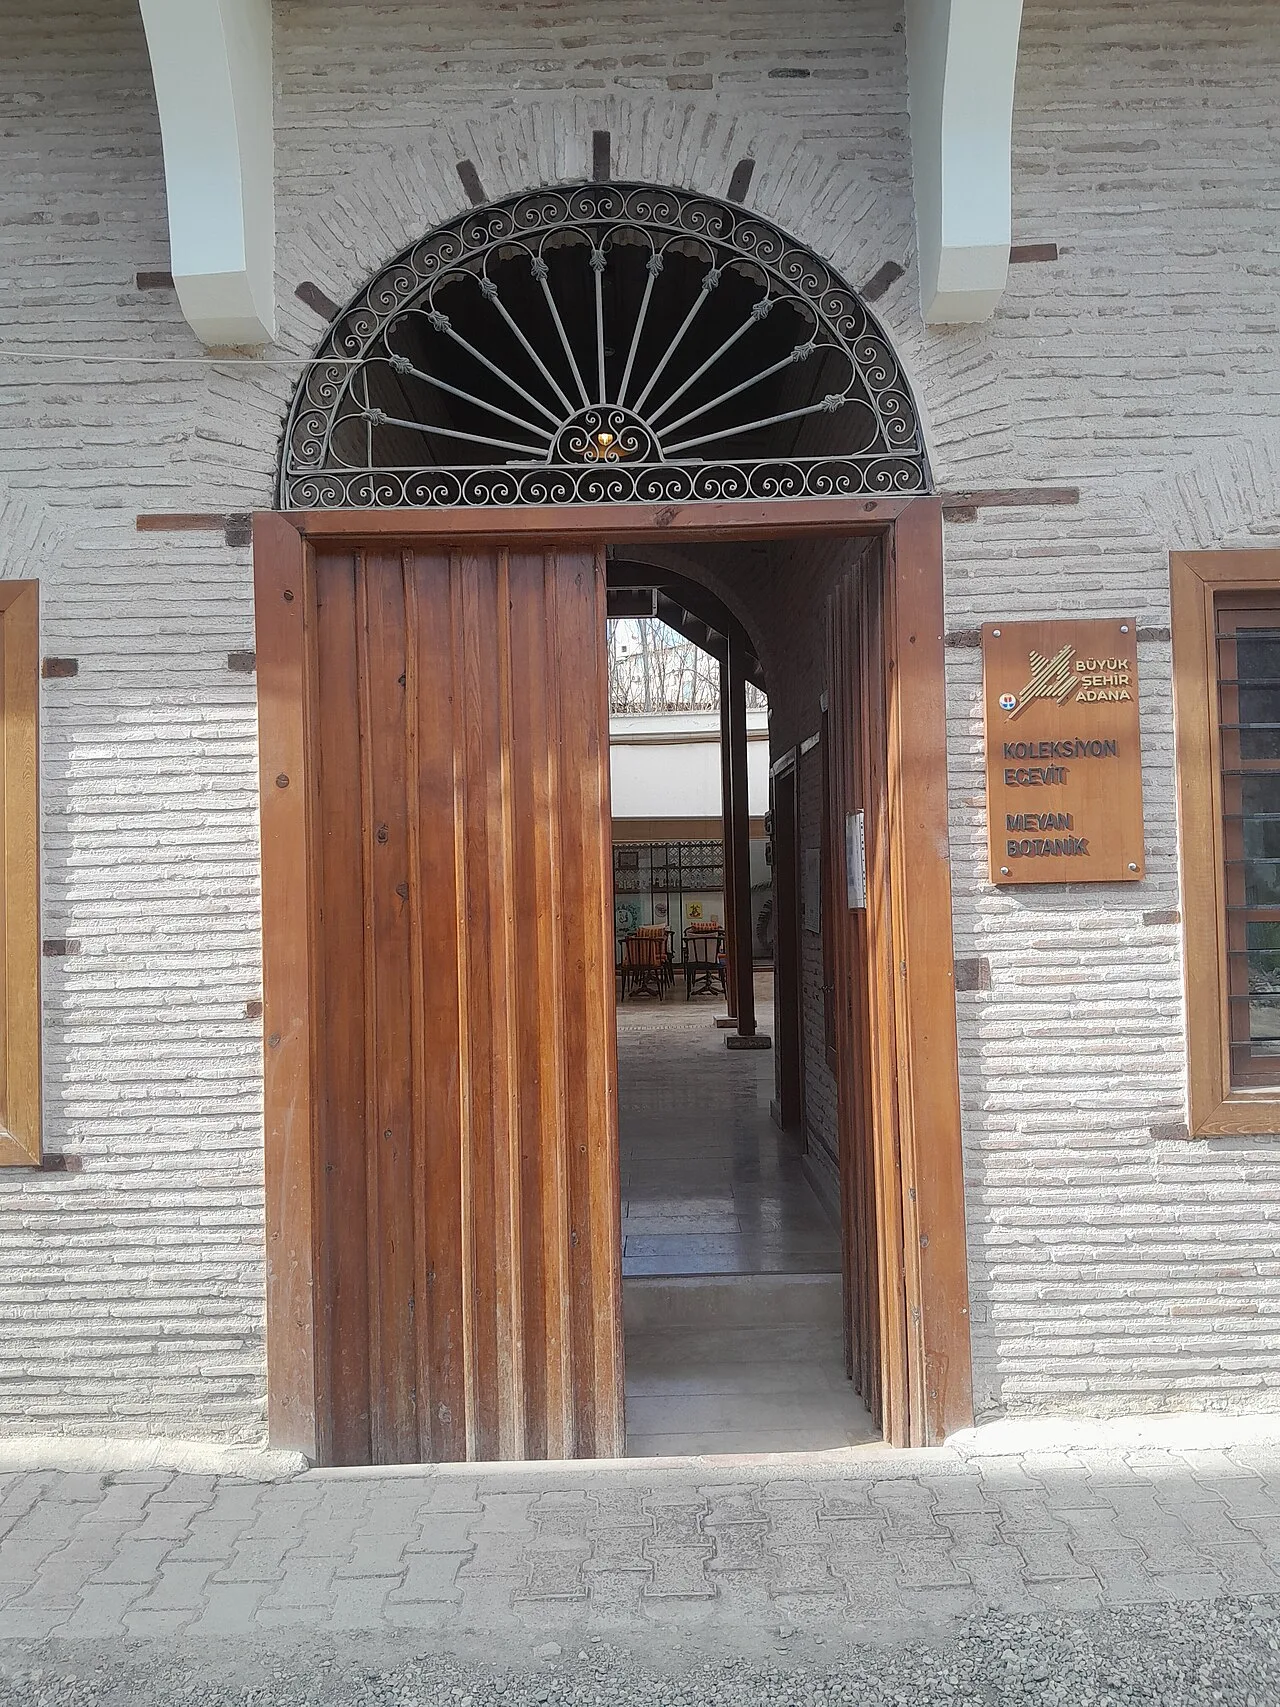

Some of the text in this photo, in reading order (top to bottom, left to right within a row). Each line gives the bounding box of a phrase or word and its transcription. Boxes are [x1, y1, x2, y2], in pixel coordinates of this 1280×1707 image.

[1076, 657, 1129, 672] BÜYÜK
[1081, 673, 1130, 690] ŞEHİR
[1075, 690, 1131, 702] ADANA
[1003, 737, 1118, 760] KOLEKSİYON
[1004, 764, 1068, 785] ECEVİT
[1006, 812, 1072, 832] MEYAN
[1006, 835, 1088, 857] BOTANİK
